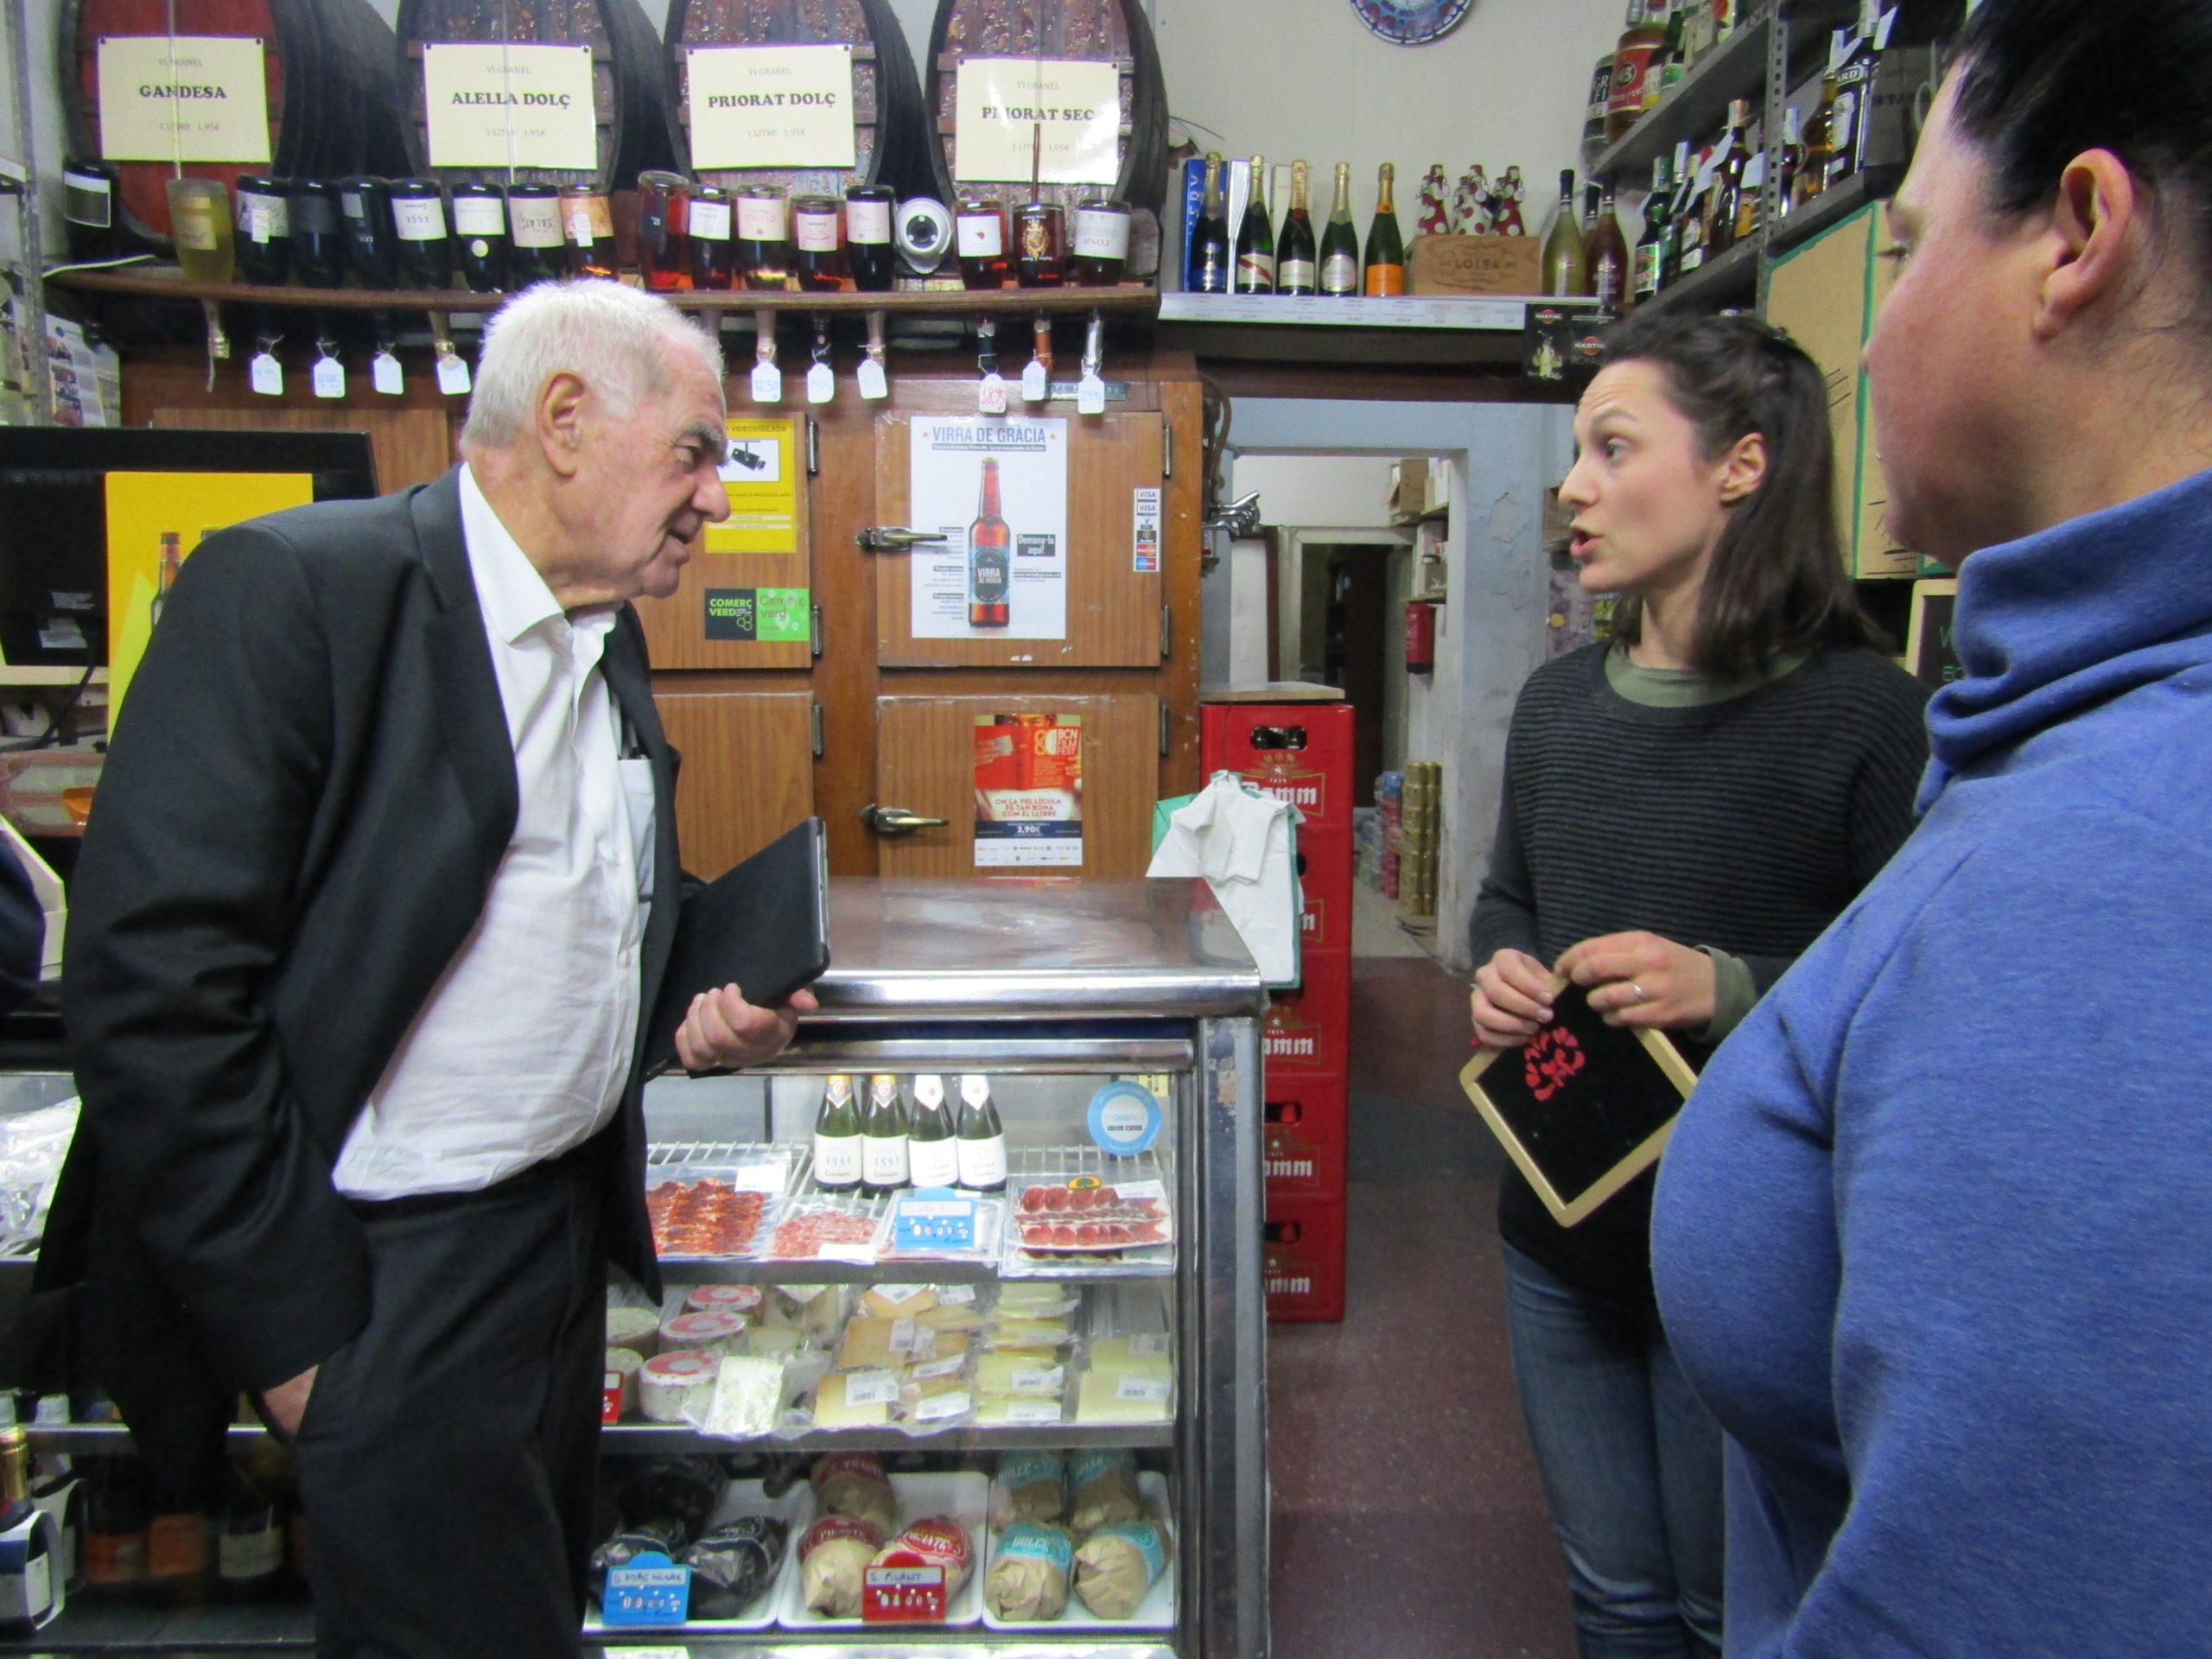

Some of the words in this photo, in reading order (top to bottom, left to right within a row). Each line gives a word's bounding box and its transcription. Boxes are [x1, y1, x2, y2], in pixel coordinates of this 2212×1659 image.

[748, 68, 758, 77] VI
[759, 67, 792, 76] GRANEL
[139, 84, 227, 99] GANDESA
[451, 92, 518, 105] ALELLA
[523, 92, 570, 110] DOLÇ
[708, 94, 785, 108] PRIORAT
[790, 92, 836, 108] DOLÇ
[1062, 109, 1095, 121] SEC
[932, 426, 973, 442] VIRRA
[976, 427, 994, 443] DE
[1018, 534, 1055, 545] Demana-la
[977, 568, 1001, 577] VIRRA
[709, 598, 753, 610] COMERÇ
[709, 607, 736, 617] VERD
[1058, 728, 1078, 740] BCN
[1057, 739, 1077, 748] FILM
[1057, 747, 1077, 756] FEST
